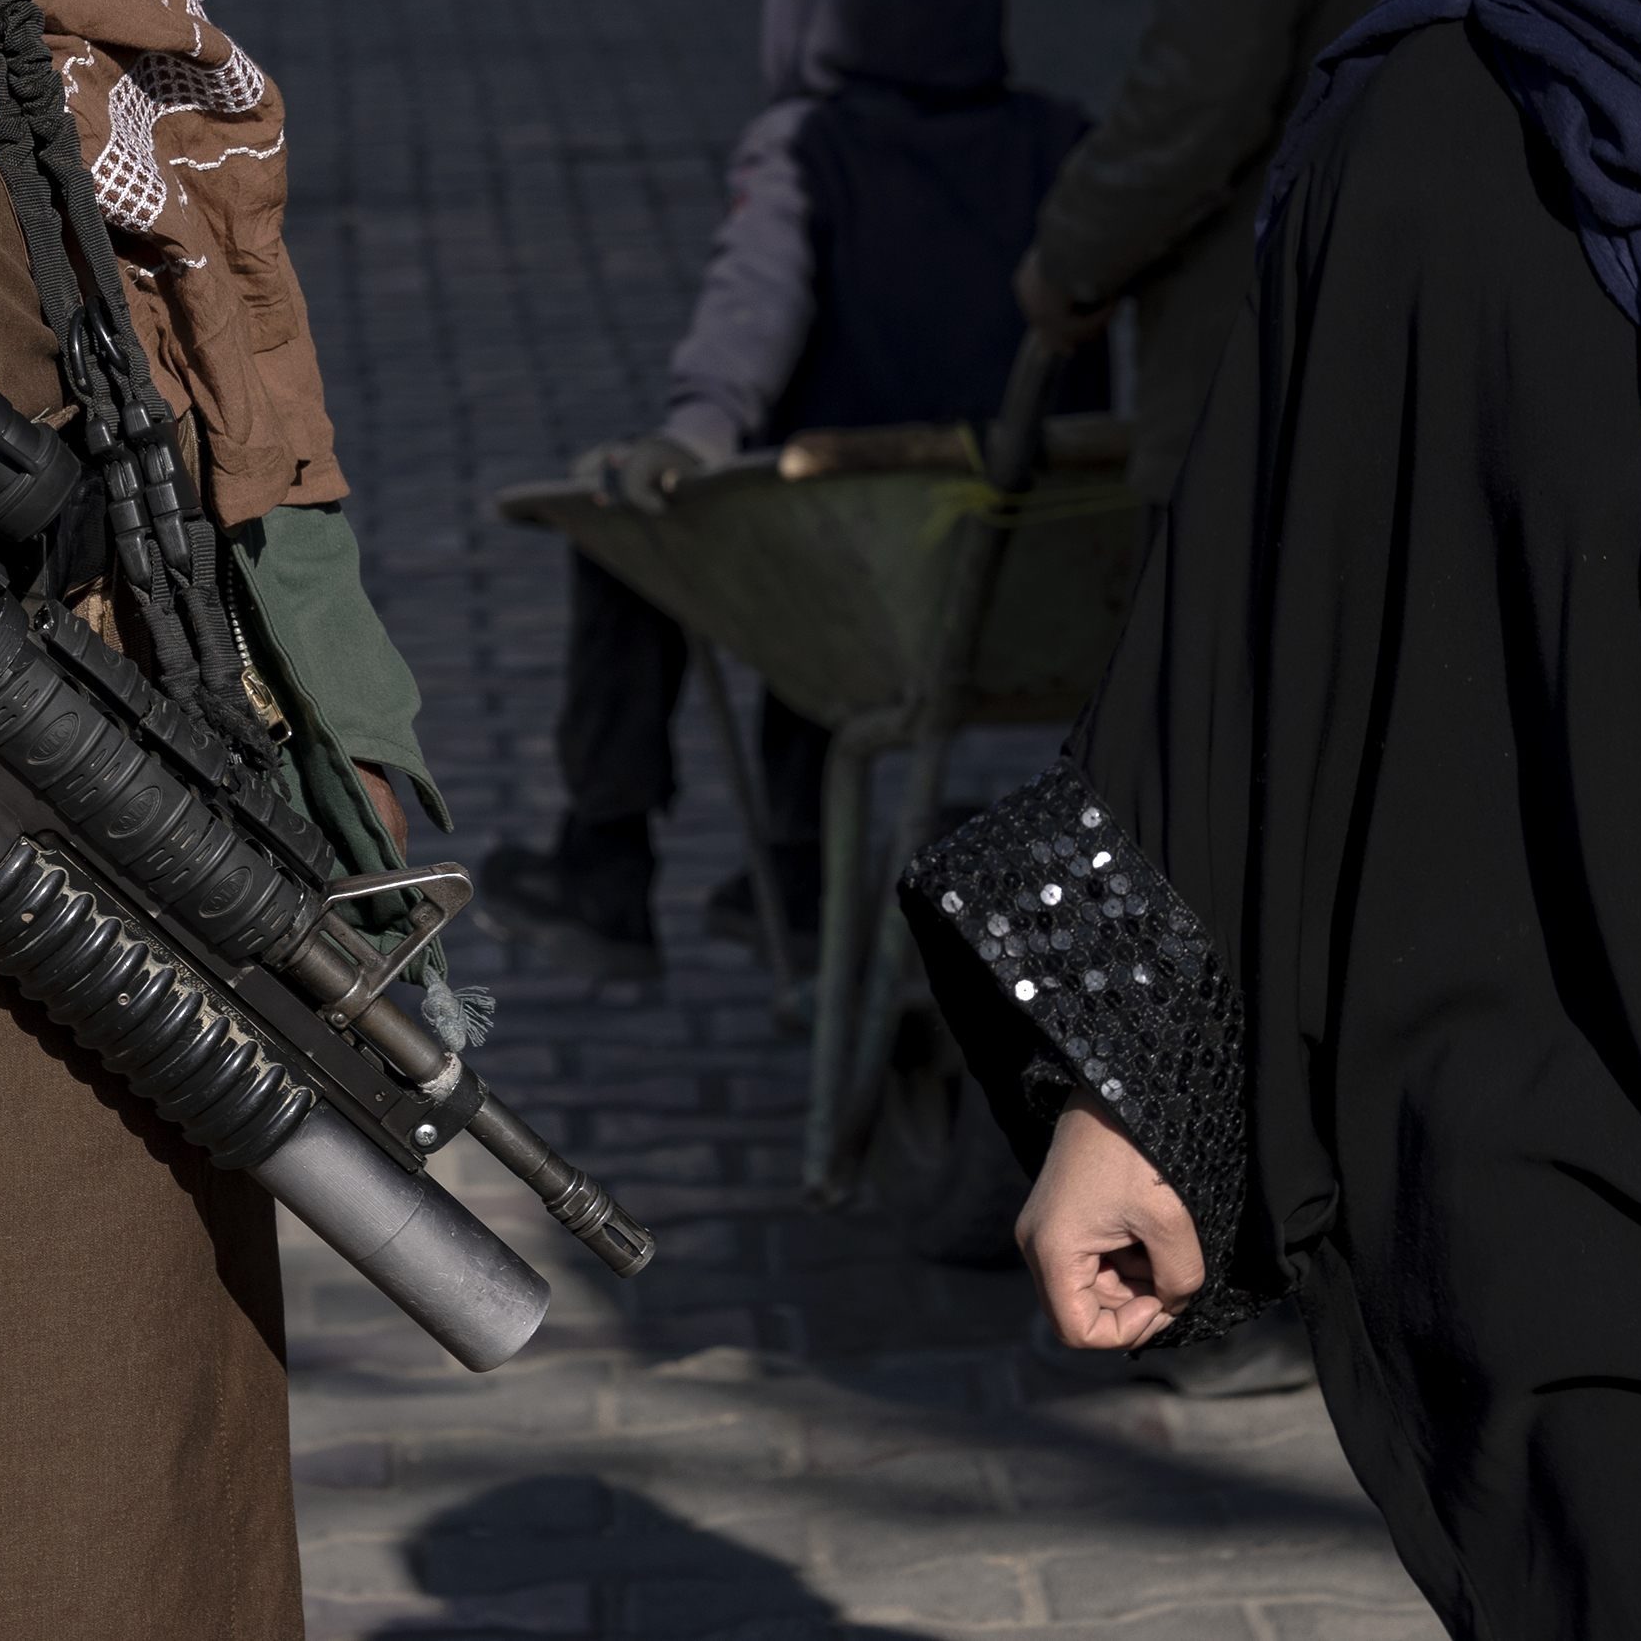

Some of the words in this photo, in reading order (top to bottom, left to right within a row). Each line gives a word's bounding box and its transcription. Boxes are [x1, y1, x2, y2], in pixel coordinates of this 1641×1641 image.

[35, 721, 73, 758] UTG
[115, 794, 154, 831] UTG
[207, 874, 245, 911] UTG
